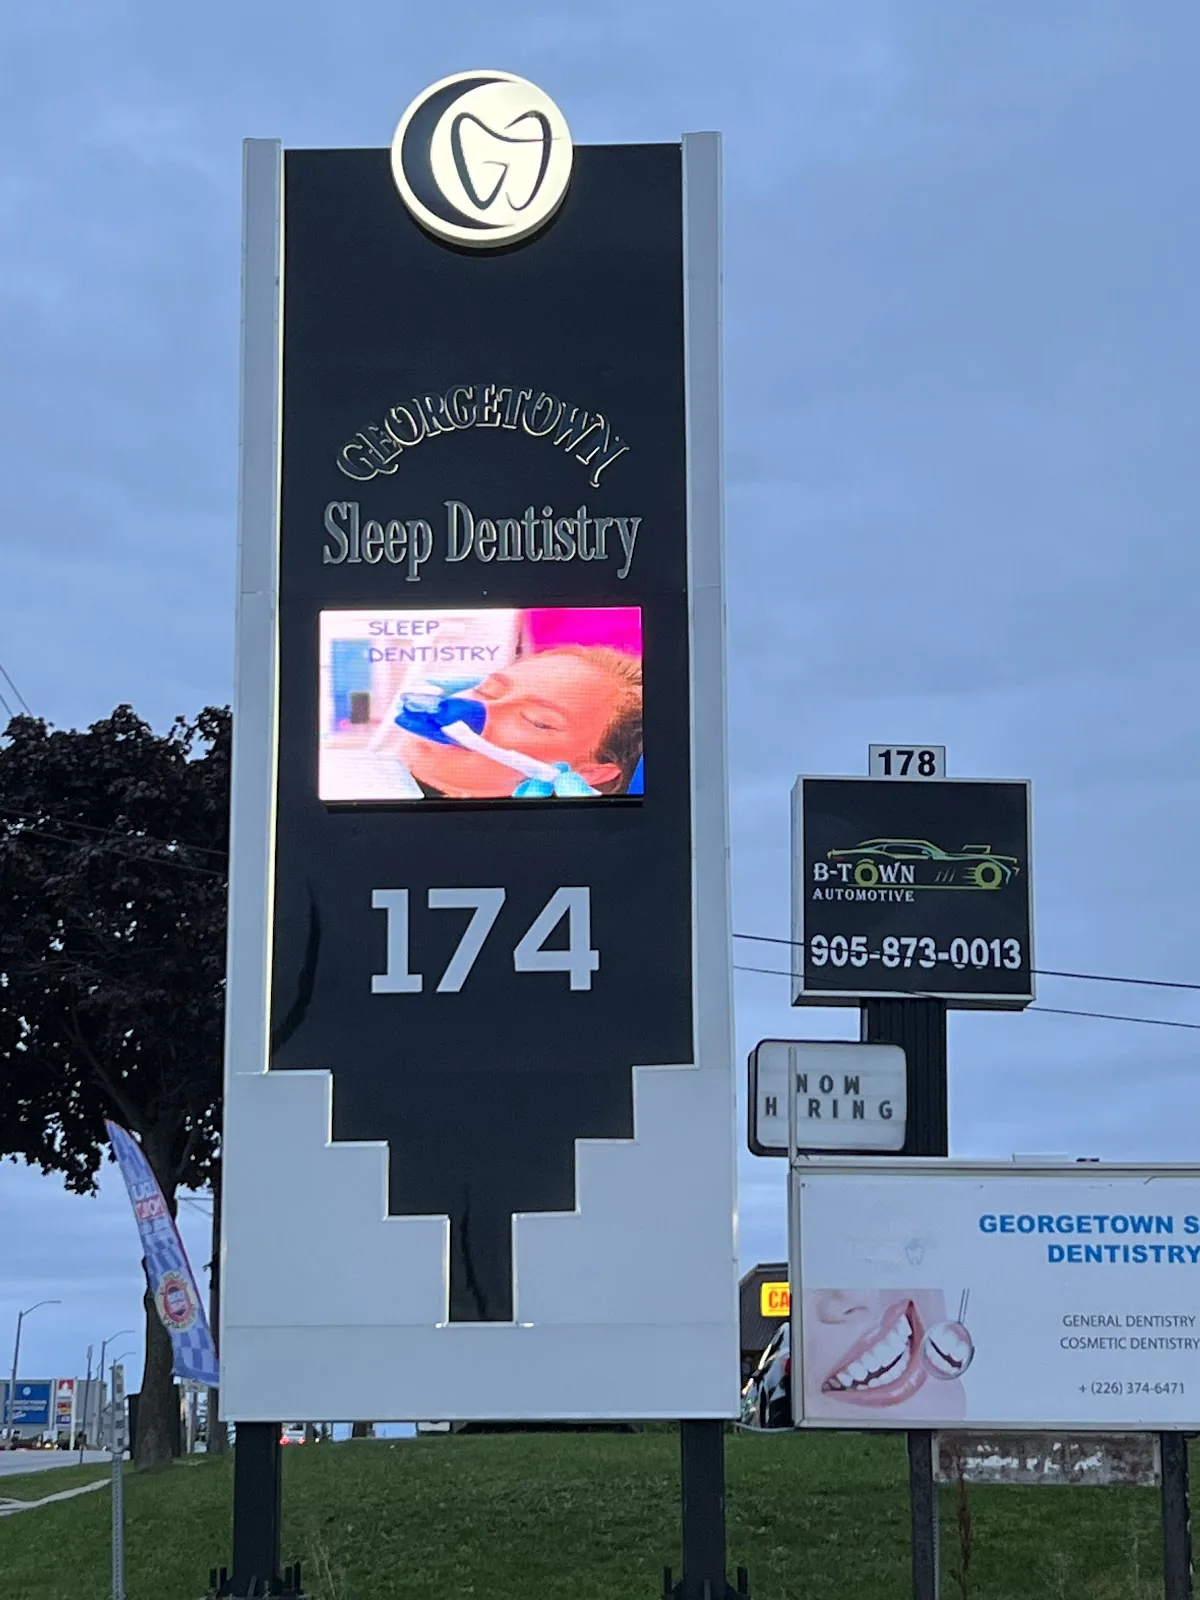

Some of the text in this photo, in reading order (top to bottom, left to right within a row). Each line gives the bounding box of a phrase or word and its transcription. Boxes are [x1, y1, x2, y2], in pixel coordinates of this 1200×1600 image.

[336, 383, 630, 488] GEORGETOWN
[322, 499, 642, 581] Sleep Dentistry
[368, 619, 440, 636] SLEEP
[368, 645, 500, 662] DENTISTRY
[878, 749, 936, 777] 178
[813, 859, 915, 886] B-TOWN
[812, 887, 915, 902] AUTOMOTIVE
[371, 886, 600, 993] 174
[810, 934, 1022, 970] 905-873-0013
[796, 1073, 861, 1095] NOW
[765, 1096, 893, 1120] HRING
[978, 1214, 1174, 1234] GEORGETOWN
[1047, 1244, 1200, 1264] DENTISTRY
[1062, 1315, 1196, 1328] GENERAL DENTISTRY
[1060, 1337, 1200, 1350] COSMETIC DENTISTRY
[1091, 1381, 1123, 1395] (226)
[1127, 1382, 1185, 1395] 374-6471
